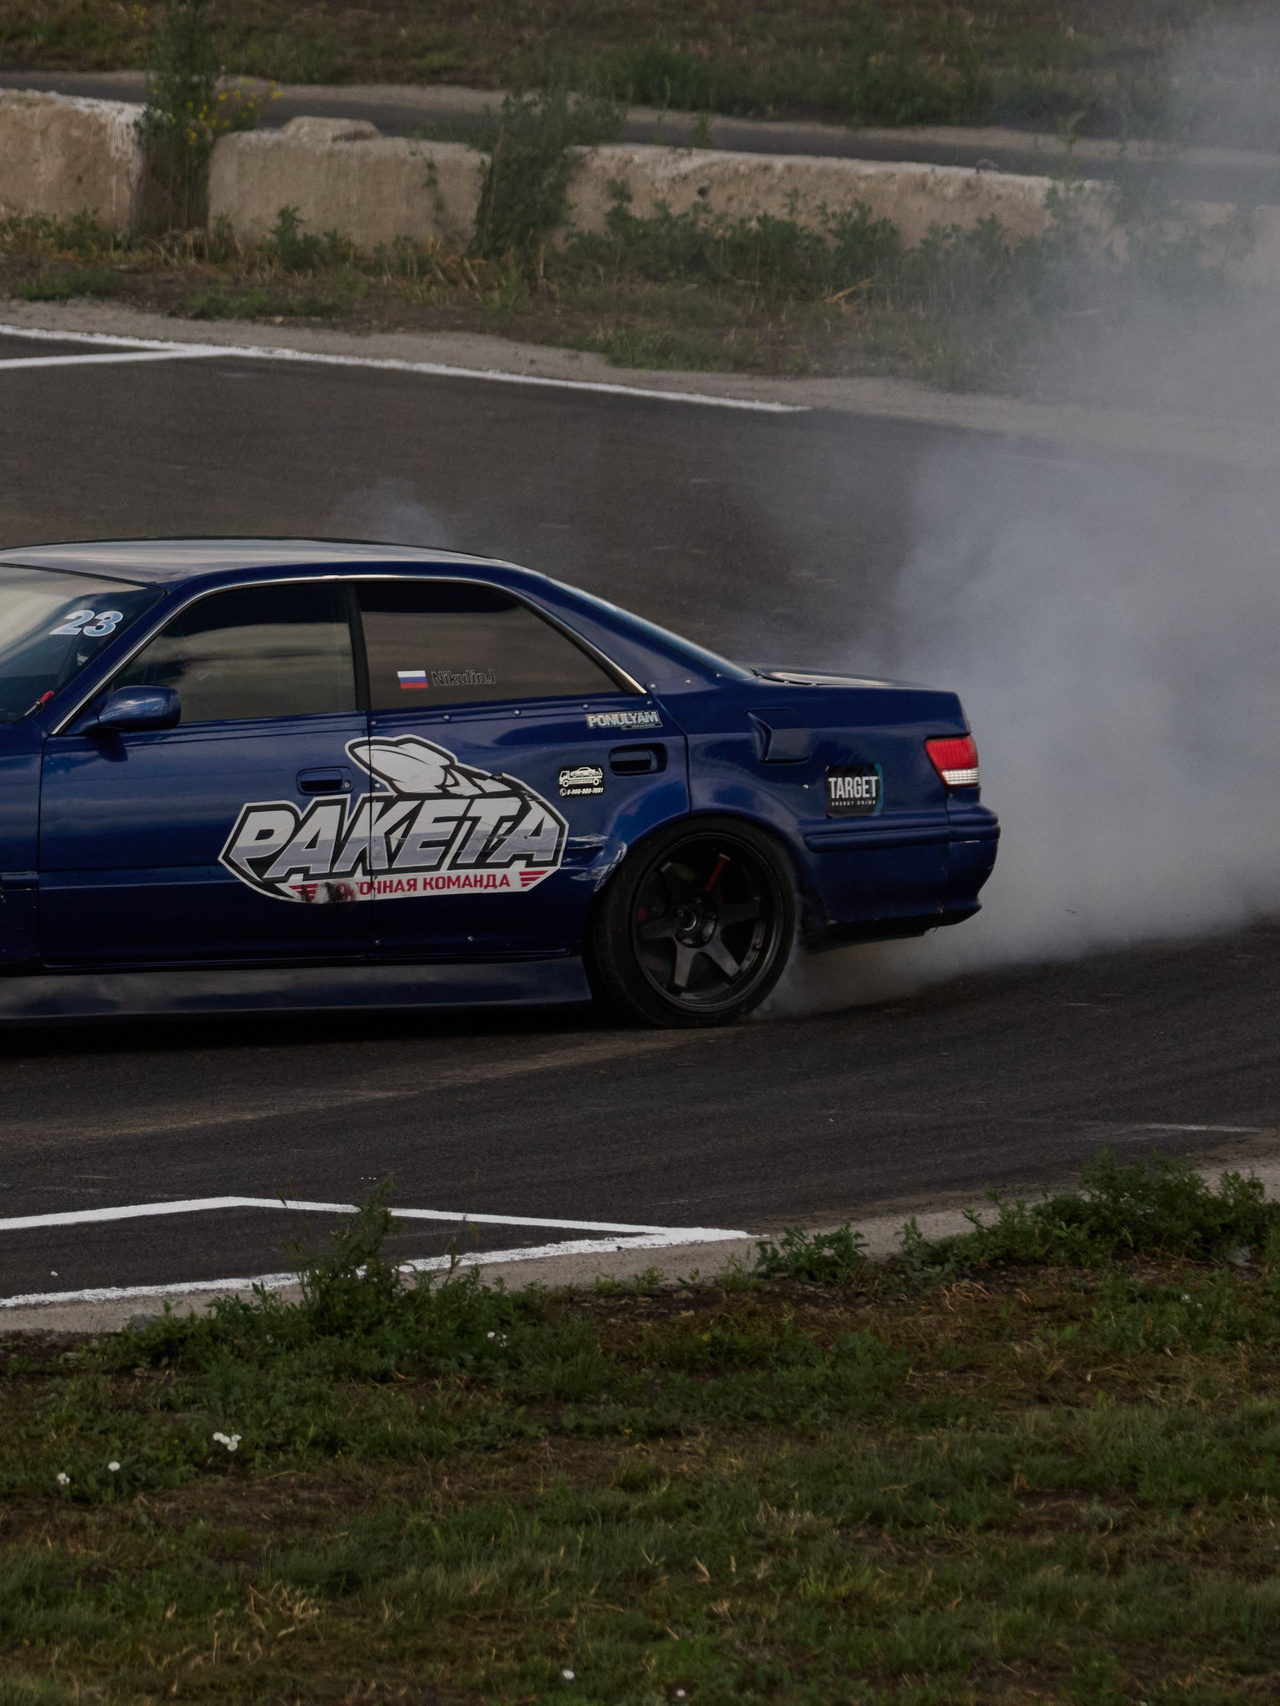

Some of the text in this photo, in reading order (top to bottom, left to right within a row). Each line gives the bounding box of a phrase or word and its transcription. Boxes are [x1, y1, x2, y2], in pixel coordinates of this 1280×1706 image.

[48, 609, 124, 637] 23
[586, 710, 660, 728] PONULYAM
[827, 775, 880, 799] TARGET
[422, 873, 511, 891] КОМАНДА
